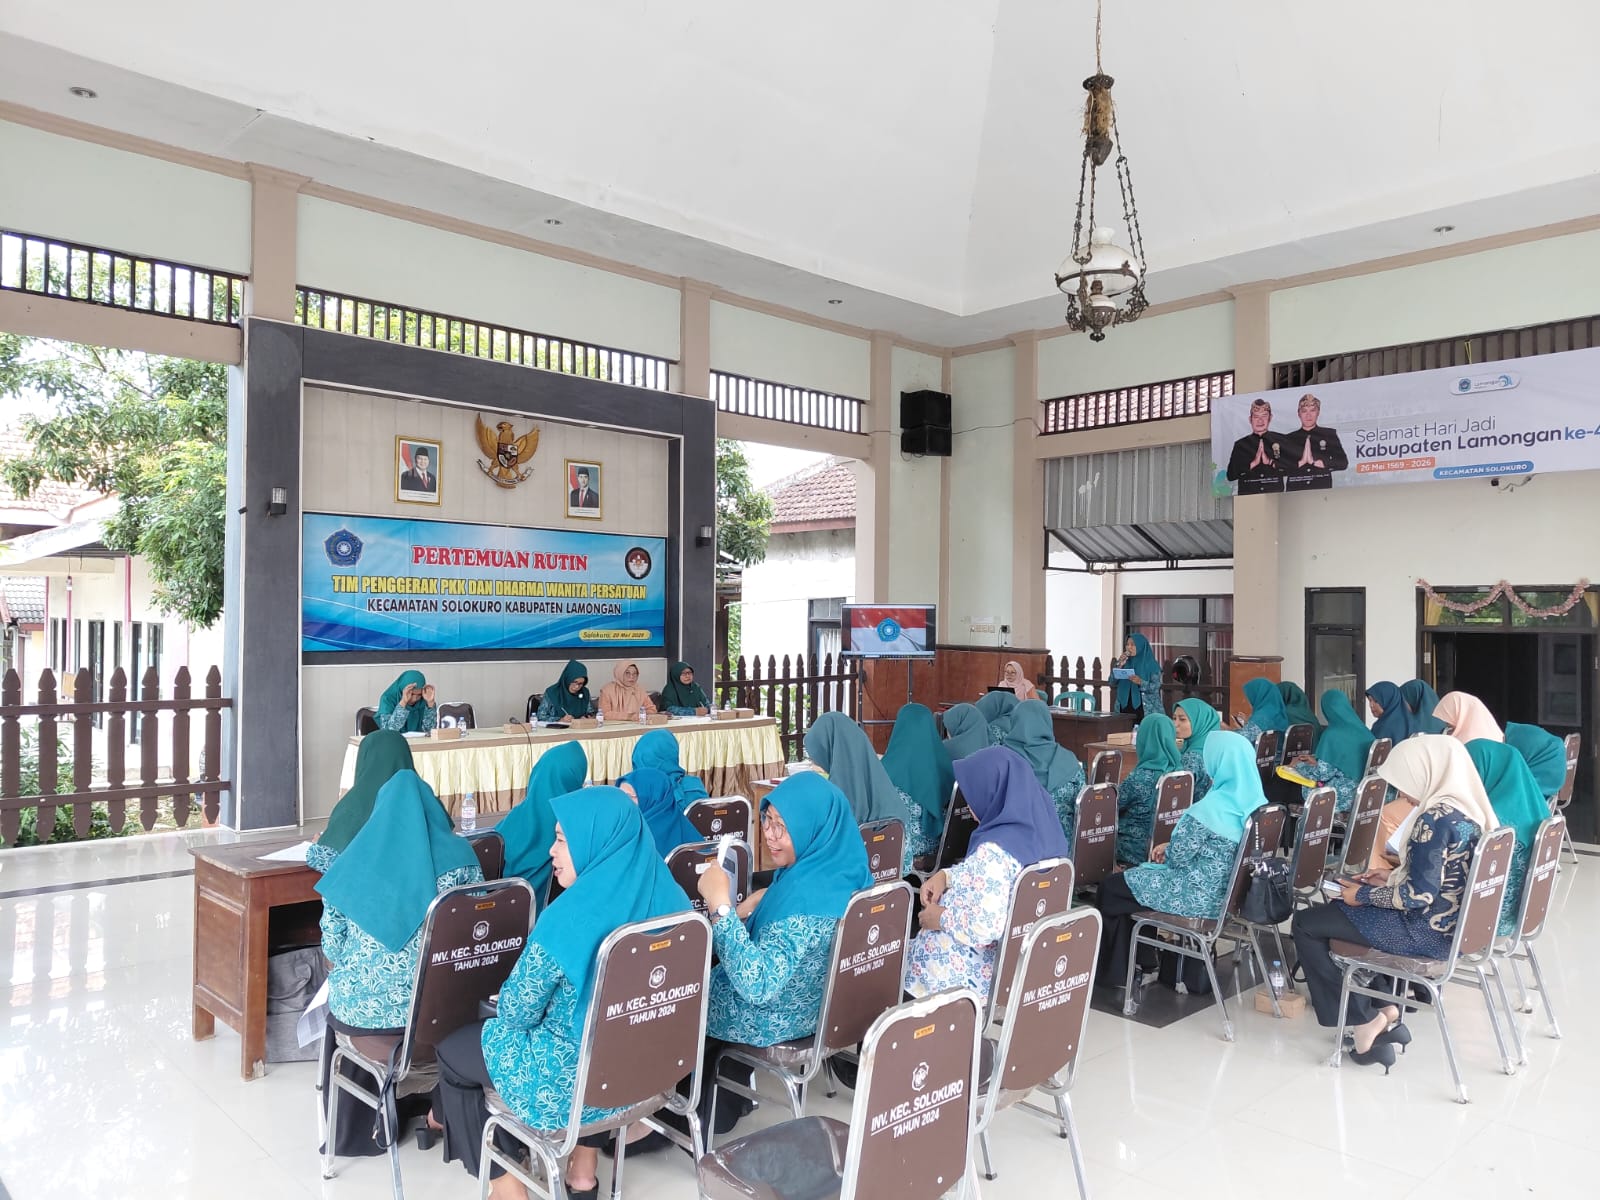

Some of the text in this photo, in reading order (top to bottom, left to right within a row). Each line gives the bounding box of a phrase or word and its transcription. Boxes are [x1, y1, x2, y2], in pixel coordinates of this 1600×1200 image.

[1355, 416, 1496, 443] Selamat Hari Jadi
[1356, 438, 1452, 459] Kabupaten
[1458, 429, 1562, 450] Lamongan
[1411, 459, 1431, 468] 2026
[1439, 463, 1528, 476] KECAMATAN SOLOKURO
[411, 544, 589, 571] PERTEMUAN RUTIN
[331, 574, 647, 600] TIM PENGGERAK PKK DAN DHARMA WANITA PERSATUAN
[367, 598, 622, 615] KECAMATAN SOLOKURO KABUPATEN LAMONGAN
[431, 936, 523, 964] INV. KEC. SOLOKURO
[867, 939, 901, 959] SOLOKURO
[454, 955, 499, 972] TAHUN 2024
[606, 982, 700, 1018] INV. KEC. SOLOKURO
[1023, 971, 1090, 1004] INV. KEC. SOLOKURO
[629, 1003, 676, 1026] TAHUN 2024
[1038, 996, 1057, 1012] TAHUN
[871, 1079, 964, 1132] INV. KEC. SOLOKURO
[892, 1107, 940, 1139] TAHUN 2024
